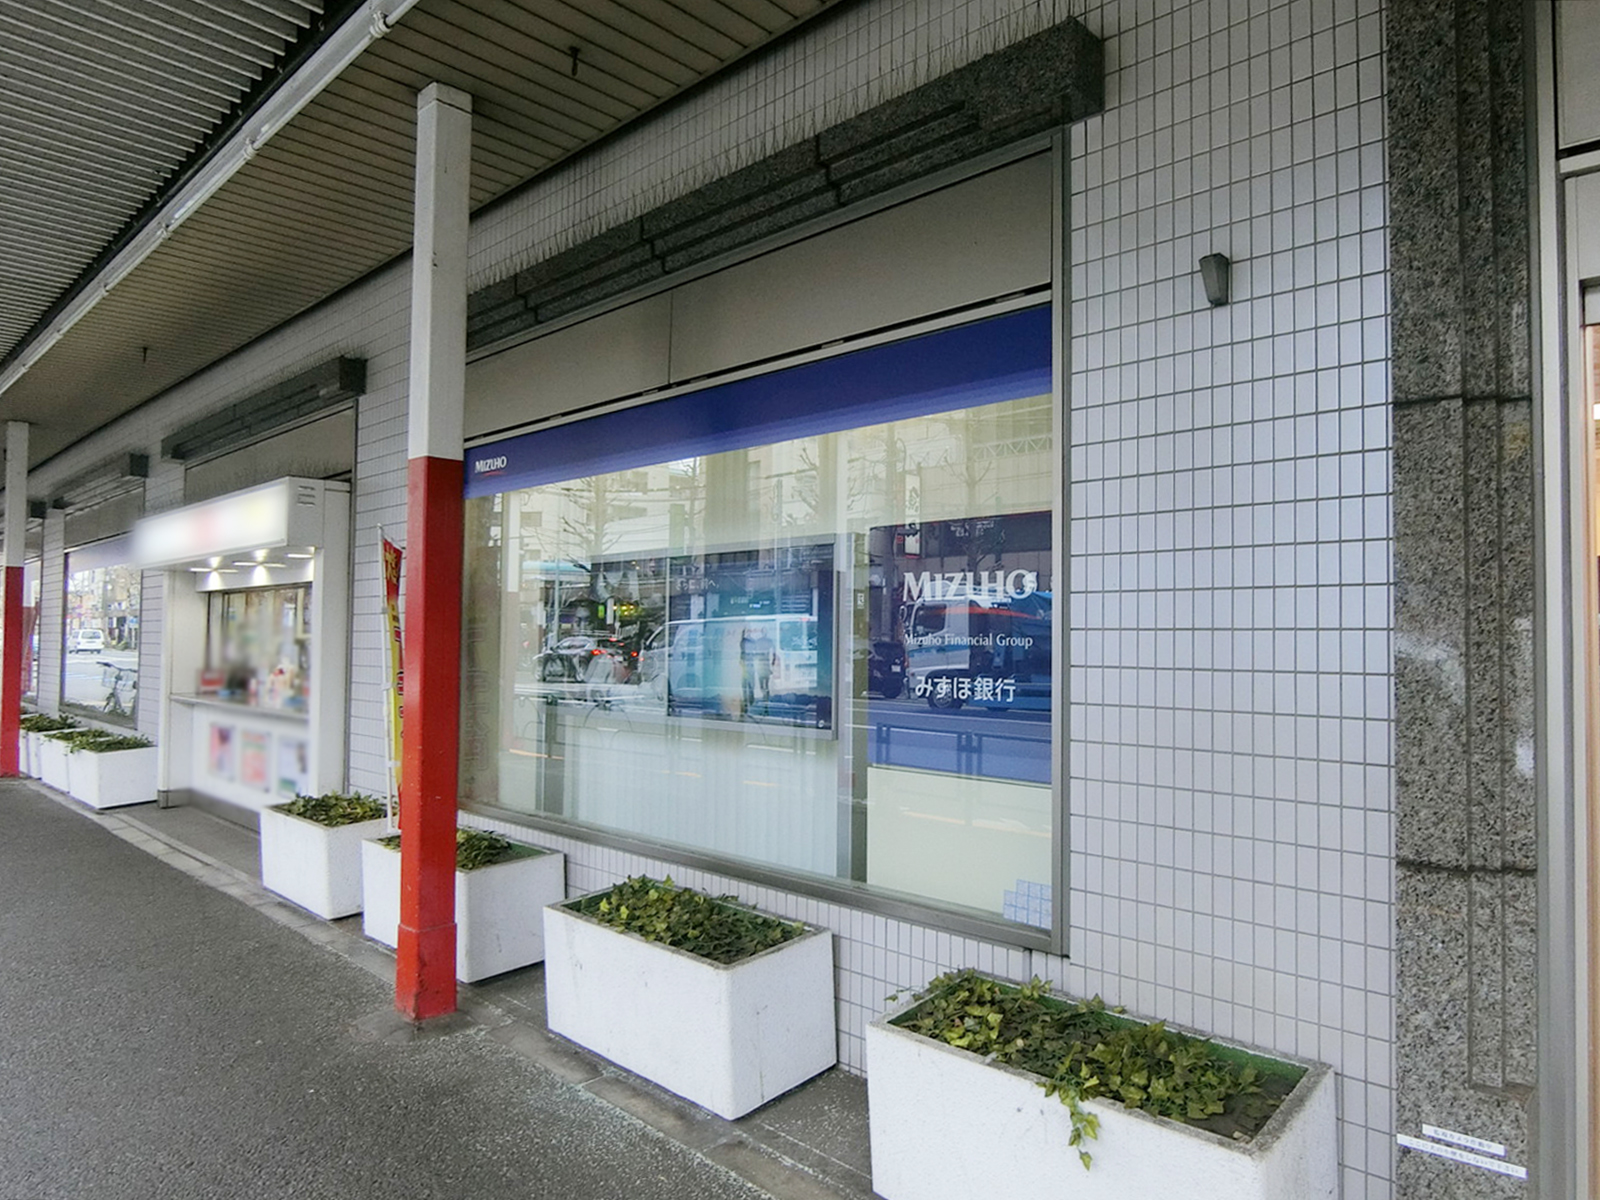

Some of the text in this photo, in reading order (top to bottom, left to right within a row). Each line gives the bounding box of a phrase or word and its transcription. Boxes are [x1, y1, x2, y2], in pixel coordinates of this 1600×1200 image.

[474, 455, 508, 473] MIZUHO
[902, 568, 1038, 601] MIZUHO
[904, 632, 1034, 650] Mizuho Financial Group
[915, 675, 1017, 703] みずほ銀行
